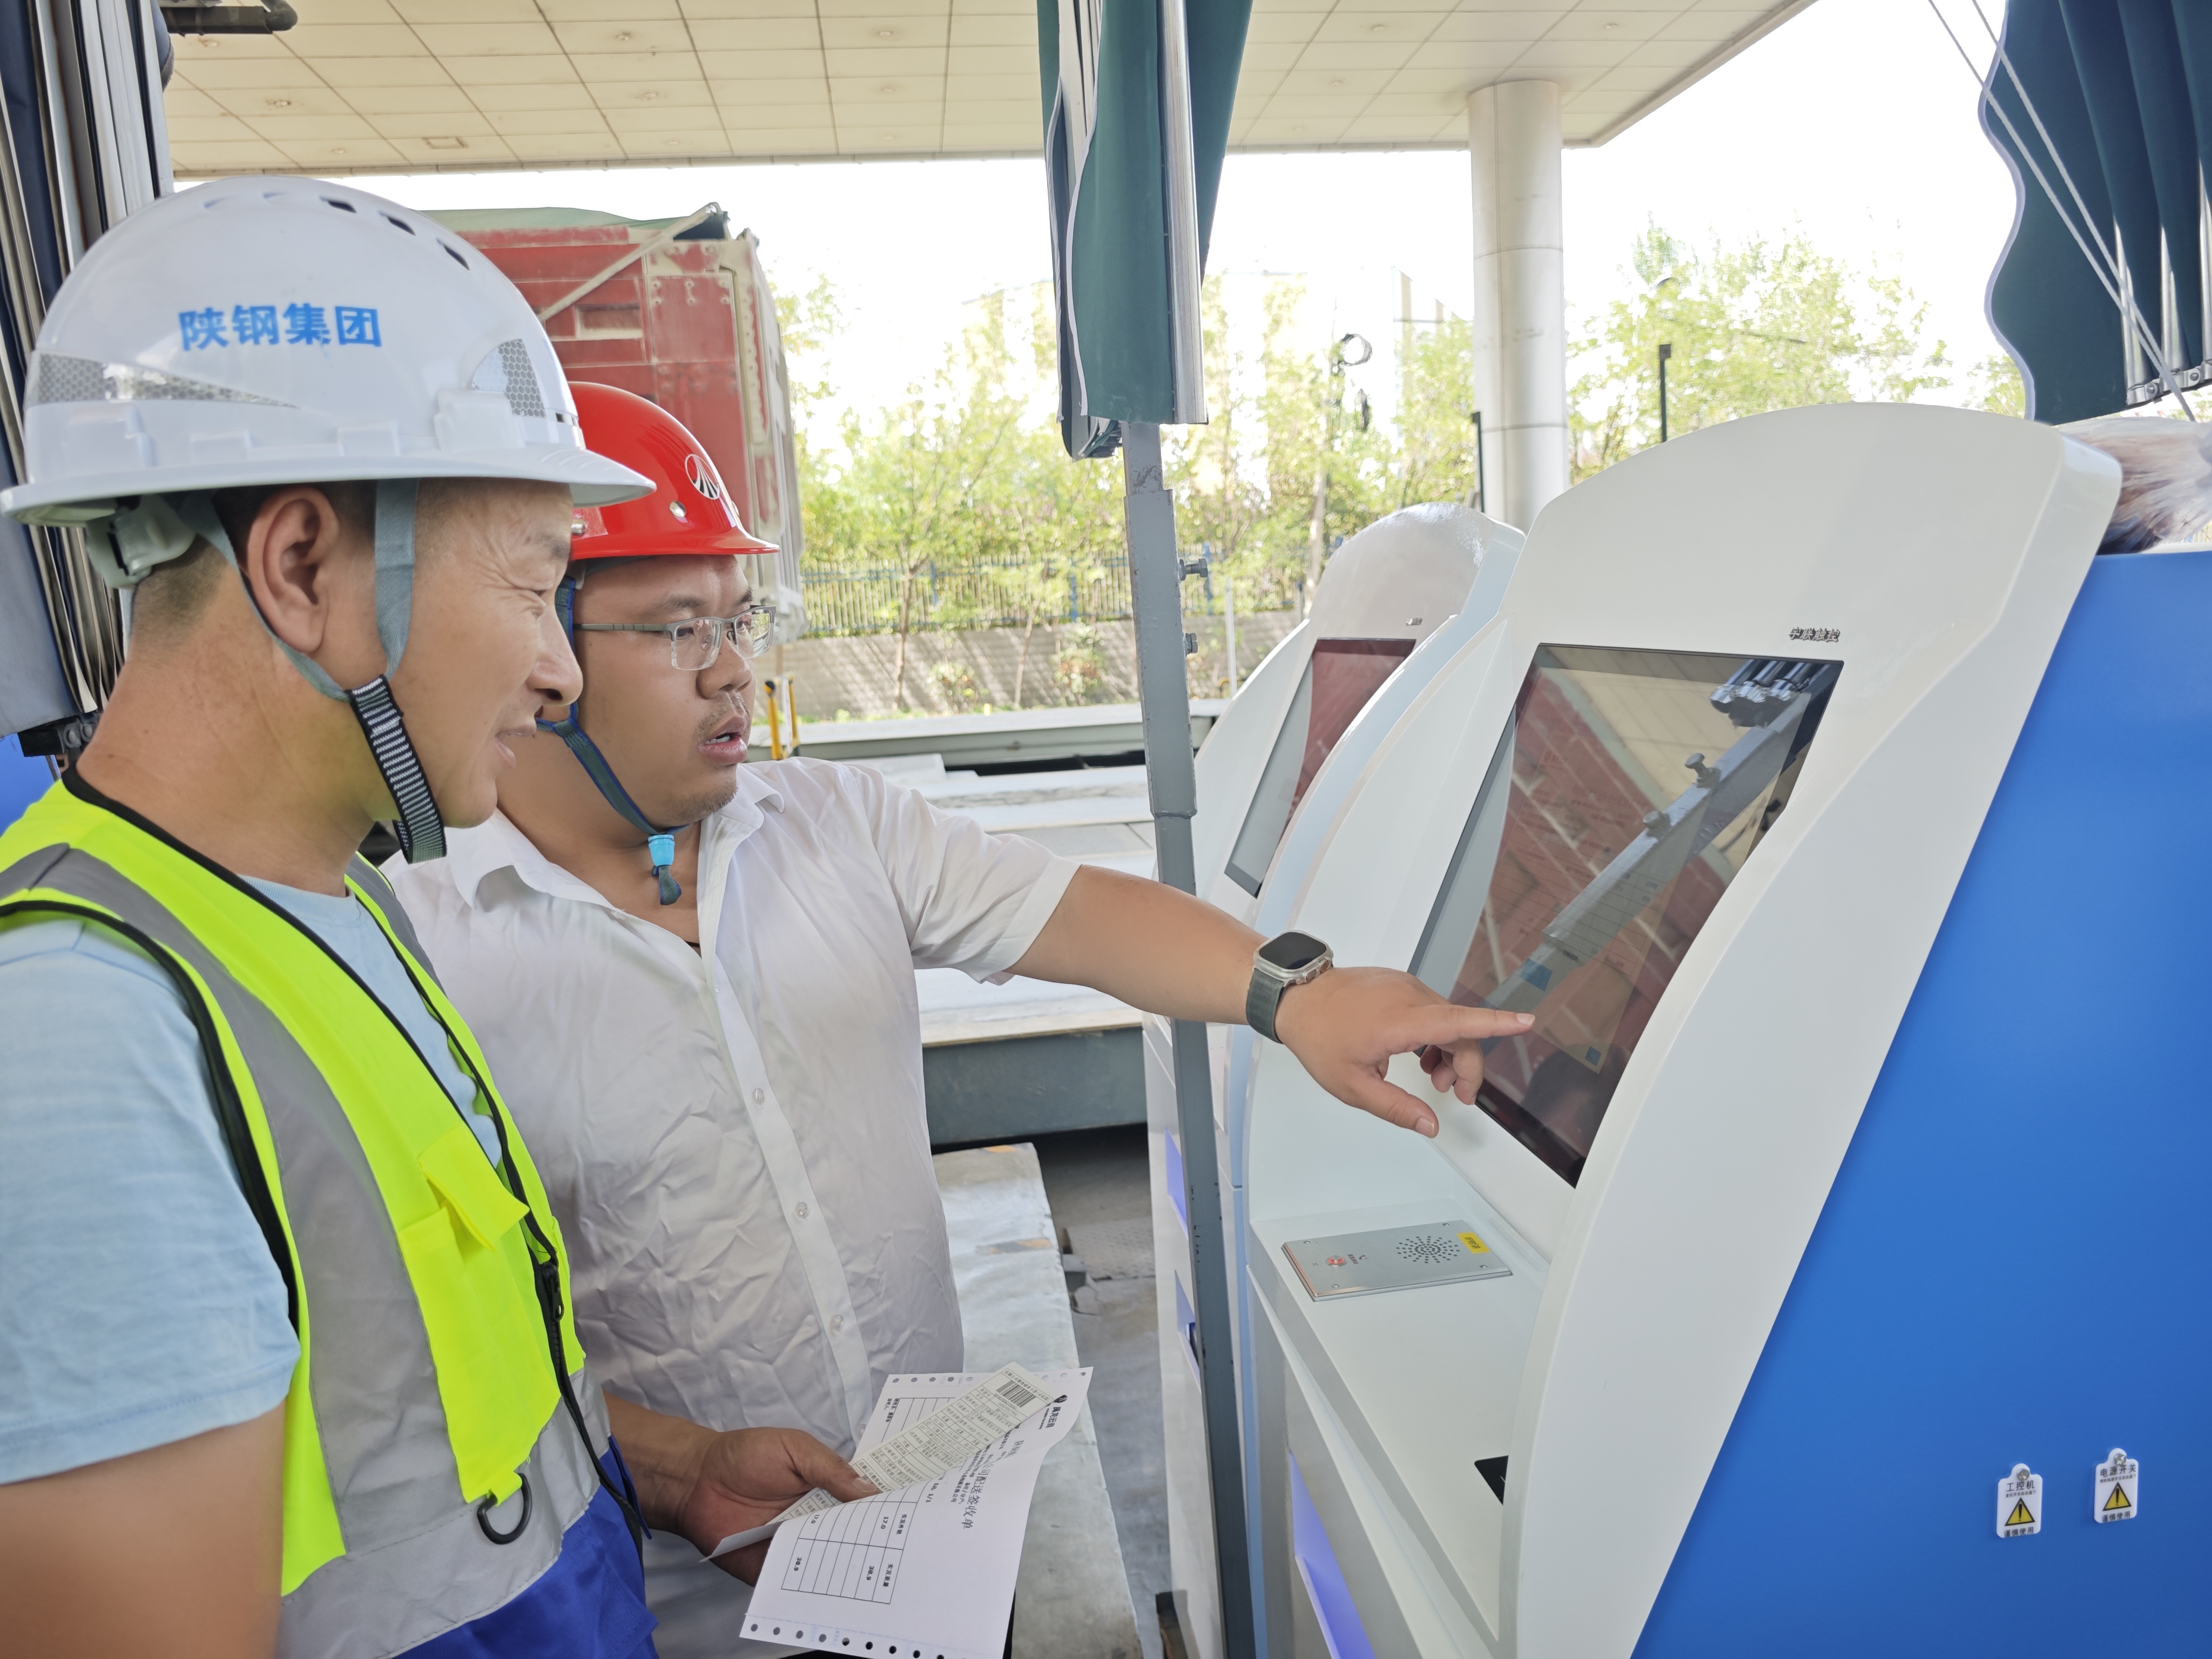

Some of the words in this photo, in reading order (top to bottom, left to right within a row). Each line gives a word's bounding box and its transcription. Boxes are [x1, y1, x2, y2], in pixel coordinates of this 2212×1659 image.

[179, 302, 382, 352] 陕钢集团
[2100, 1464, 2136, 1477] 电源开关
[2005, 1480, 2035, 1492] 工控机
[925, 1493, 934, 1503] 1/1
[811, 1514, 820, 1524] 17.0
[880, 1516, 889, 1529] 17.0
[2101, 1510, 2131, 1522] 谨慎使用
[896, 1514, 907, 1535] 实发件数
[2004, 1526, 2034, 1537] 谨慎使用
[793, 1557, 802, 1572] 38.9
[866, 1566, 875, 1581] 38.9
[882, 1563, 894, 1588] 实发重量
